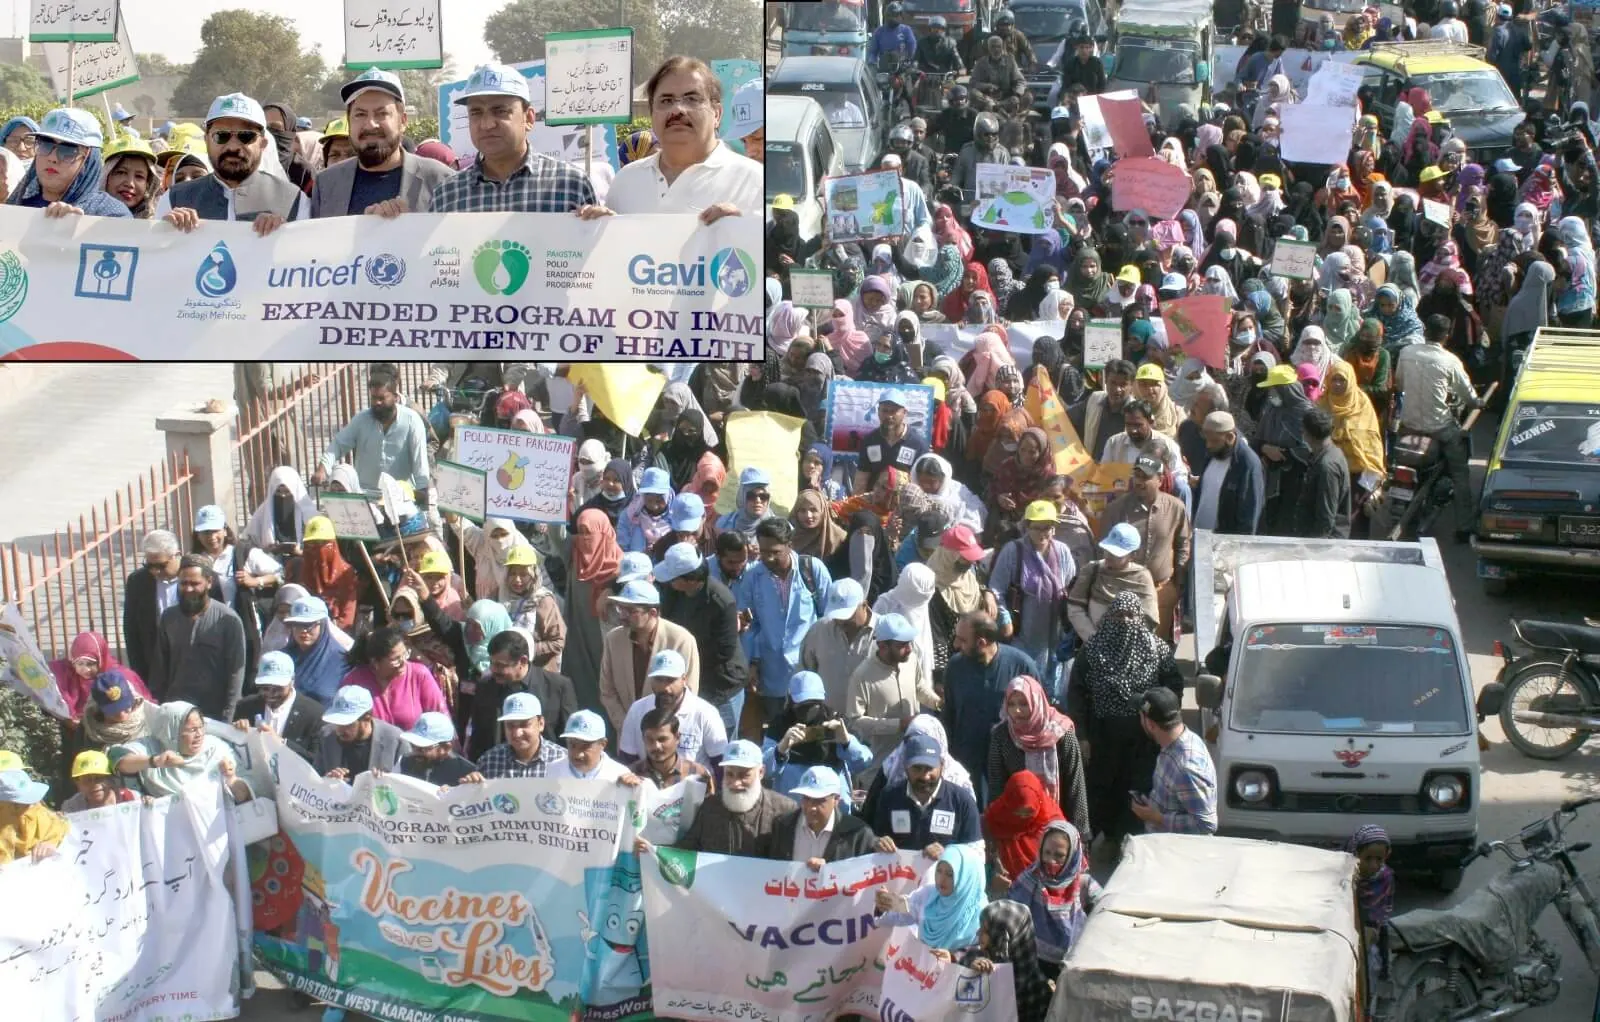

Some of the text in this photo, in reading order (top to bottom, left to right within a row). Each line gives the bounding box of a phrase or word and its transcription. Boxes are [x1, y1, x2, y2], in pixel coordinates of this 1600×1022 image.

[96, 8, 111, 25] ایک
[388, 17, 396, 26] دو
[397, 8, 412, 26] کے
[414, 7, 434, 32] پولیو
[369, 32, 416, 54] ہر بچہ ہر بار
[267, 254, 364, 288] unicef
[433, 258, 461, 267] انسداد
[439, 268, 460, 278] پولیو
[546, 260, 568, 268] POLIO
[628, 254, 705, 286] Gavi
[430, 277, 460, 289] پروگرام
[546, 271, 595, 279] ERADICATION
[546, 281, 593, 290] PROGRAMME
[647, 288, 674, 296] Vaccine
[677, 288, 705, 296] Alliance
[176, 310, 247, 321] Zindagi Mehfooz
[261, 302, 764, 336] EXPANDED PROGRAM ON IMM
[319, 326, 756, 361] DEPARTMENT OF HEALTH
[1510, 420, 1556, 446] RIZWAN
[497, 434, 521, 447] FREE
[526, 438, 571, 455] PAKISTAN
[448, 797, 493, 818] Gavi
[568, 796, 590, 808] World
[568, 806, 618, 821] Organization
[376, 818, 450, 834] OGRAM
[456, 825, 484, 836] ON
[490, 821, 617, 845] IMMUNIZATION
[422, 835, 448, 845] OF
[454, 831, 534, 845] HEALTH,
[538, 833, 590, 853] SINDH
[355, 850, 528, 923] Vaccines
[842, 862, 918, 897] حفاظتی
[729, 912, 880, 951] VACCIN
[383, 920, 548, 992] save Lives
[169, 991, 198, 1000] TIME
[296, 976, 344, 1002] DISTRICT
[344, 992, 382, 1014] WEST
